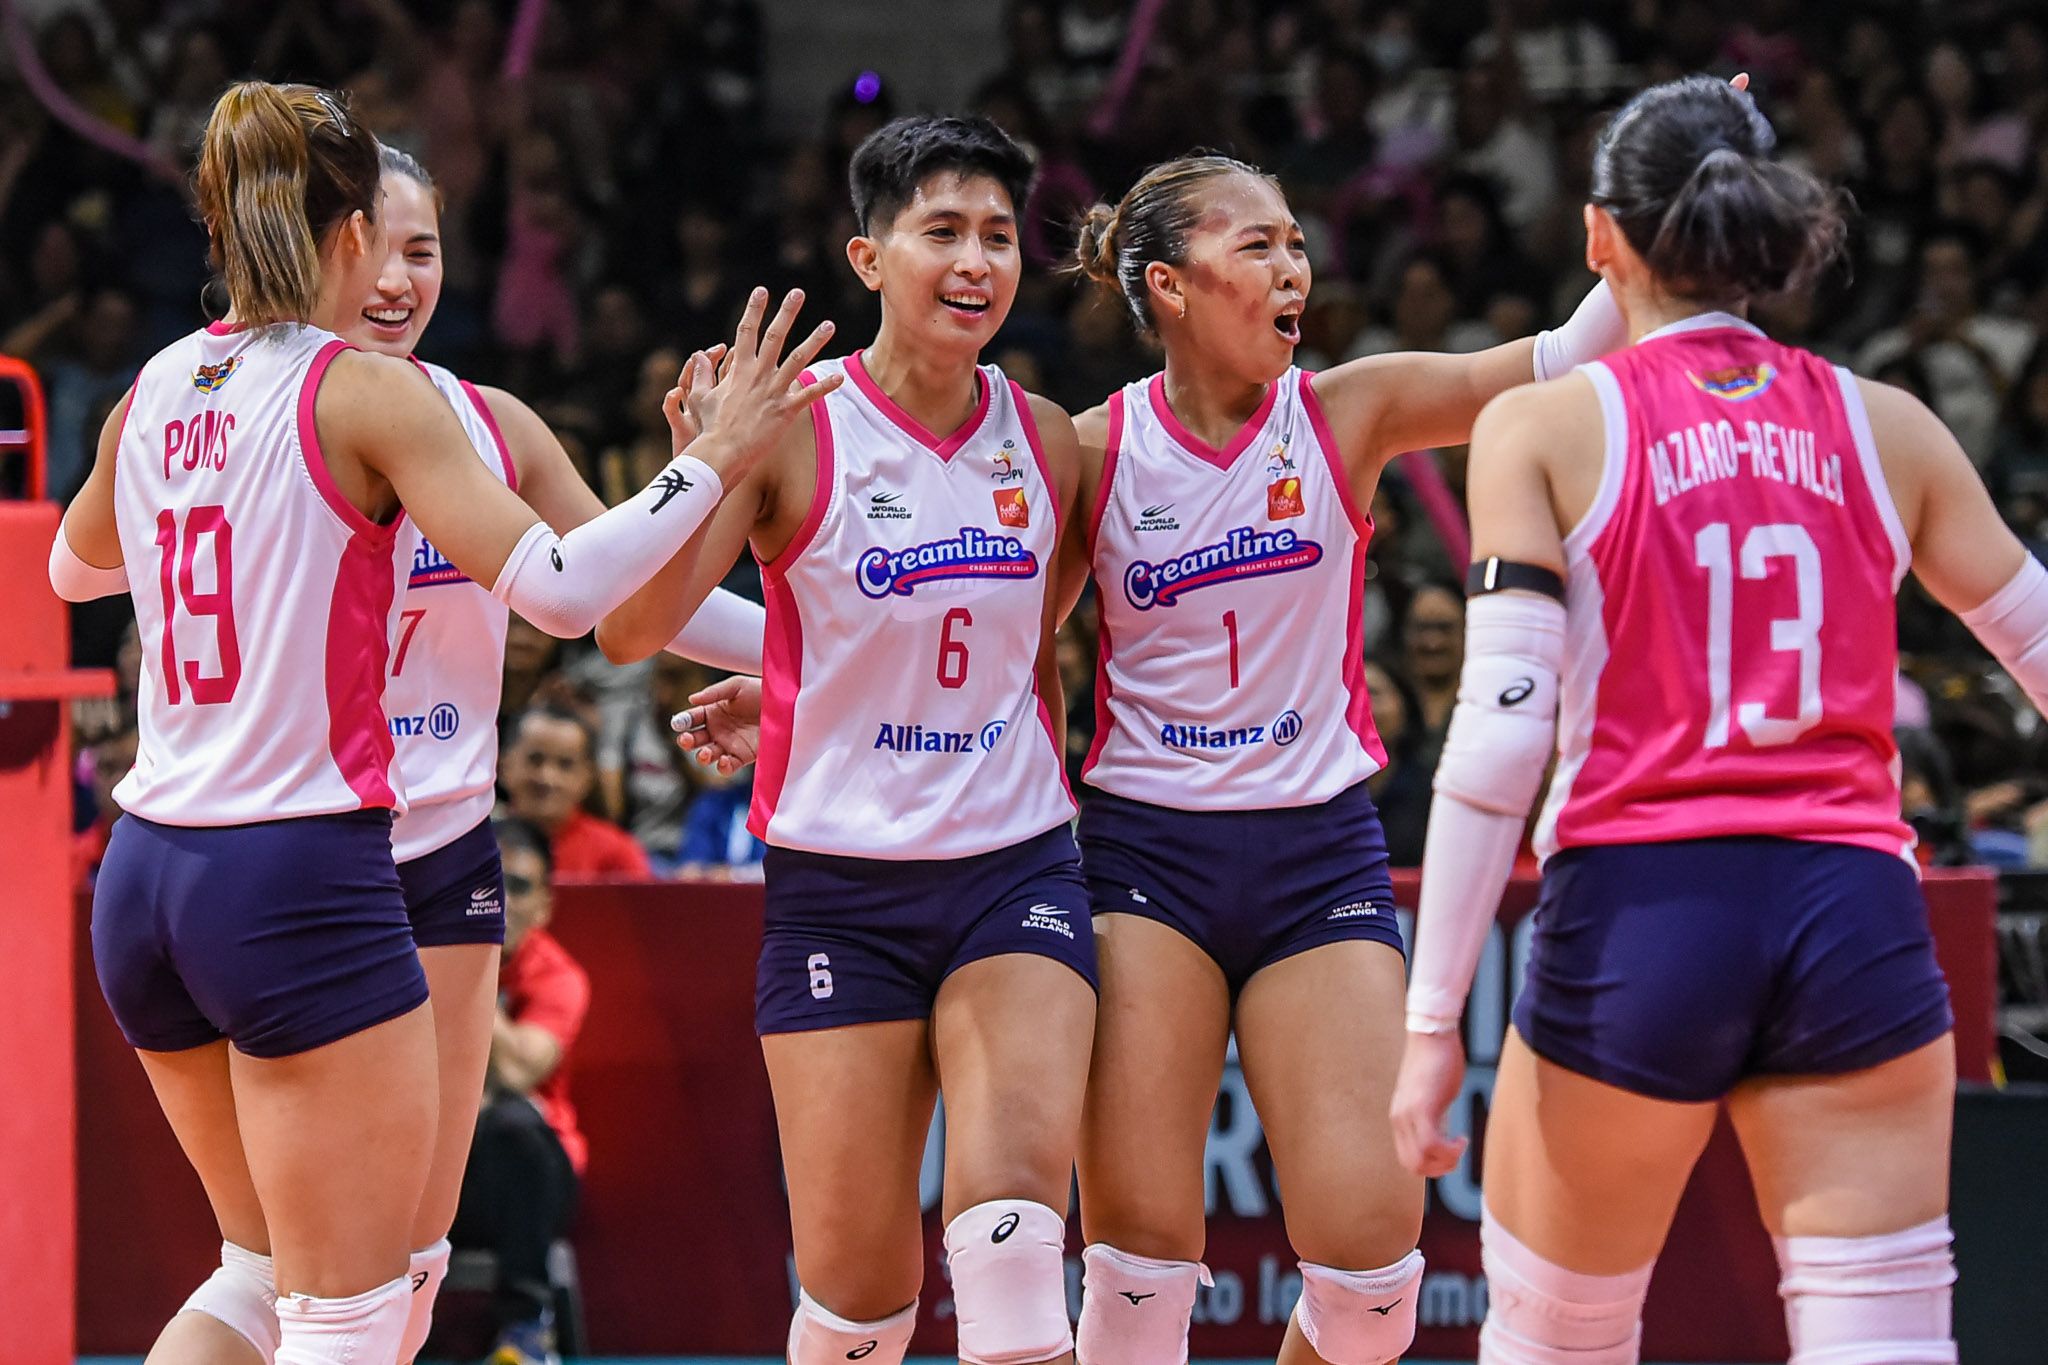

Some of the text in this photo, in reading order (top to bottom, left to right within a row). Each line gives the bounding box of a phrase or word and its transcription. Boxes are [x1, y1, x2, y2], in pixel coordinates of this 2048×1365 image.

[164, 410, 236, 481] PONS
[1012, 468, 1023, 480] PV
[867, 512, 912, 520] BALANCE
[871, 505, 907, 513] WORLD
[1140, 517, 1175, 525] WORLD
[1133, 523, 1180, 532] BALANCE
[859, 530, 1020, 595] Creamline
[1126, 529, 1293, 607] Creamline
[1235, 562, 1267, 573] CREAMY
[1269, 560, 1282, 568] ICE
[155, 505, 241, 705] 19
[1694, 521, 1824, 749] 13
[936, 608, 972, 689] 6
[1222, 610, 1239, 689] 1
[873, 723, 974, 753] Allianz
[1160, 723, 1264, 748] Allianz
[471, 900, 499, 908] WORLD
[1022, 920, 1074, 940] BALANCE
[1029, 914, 1070, 930] WORLD
[807, 953, 833, 1000] 6
